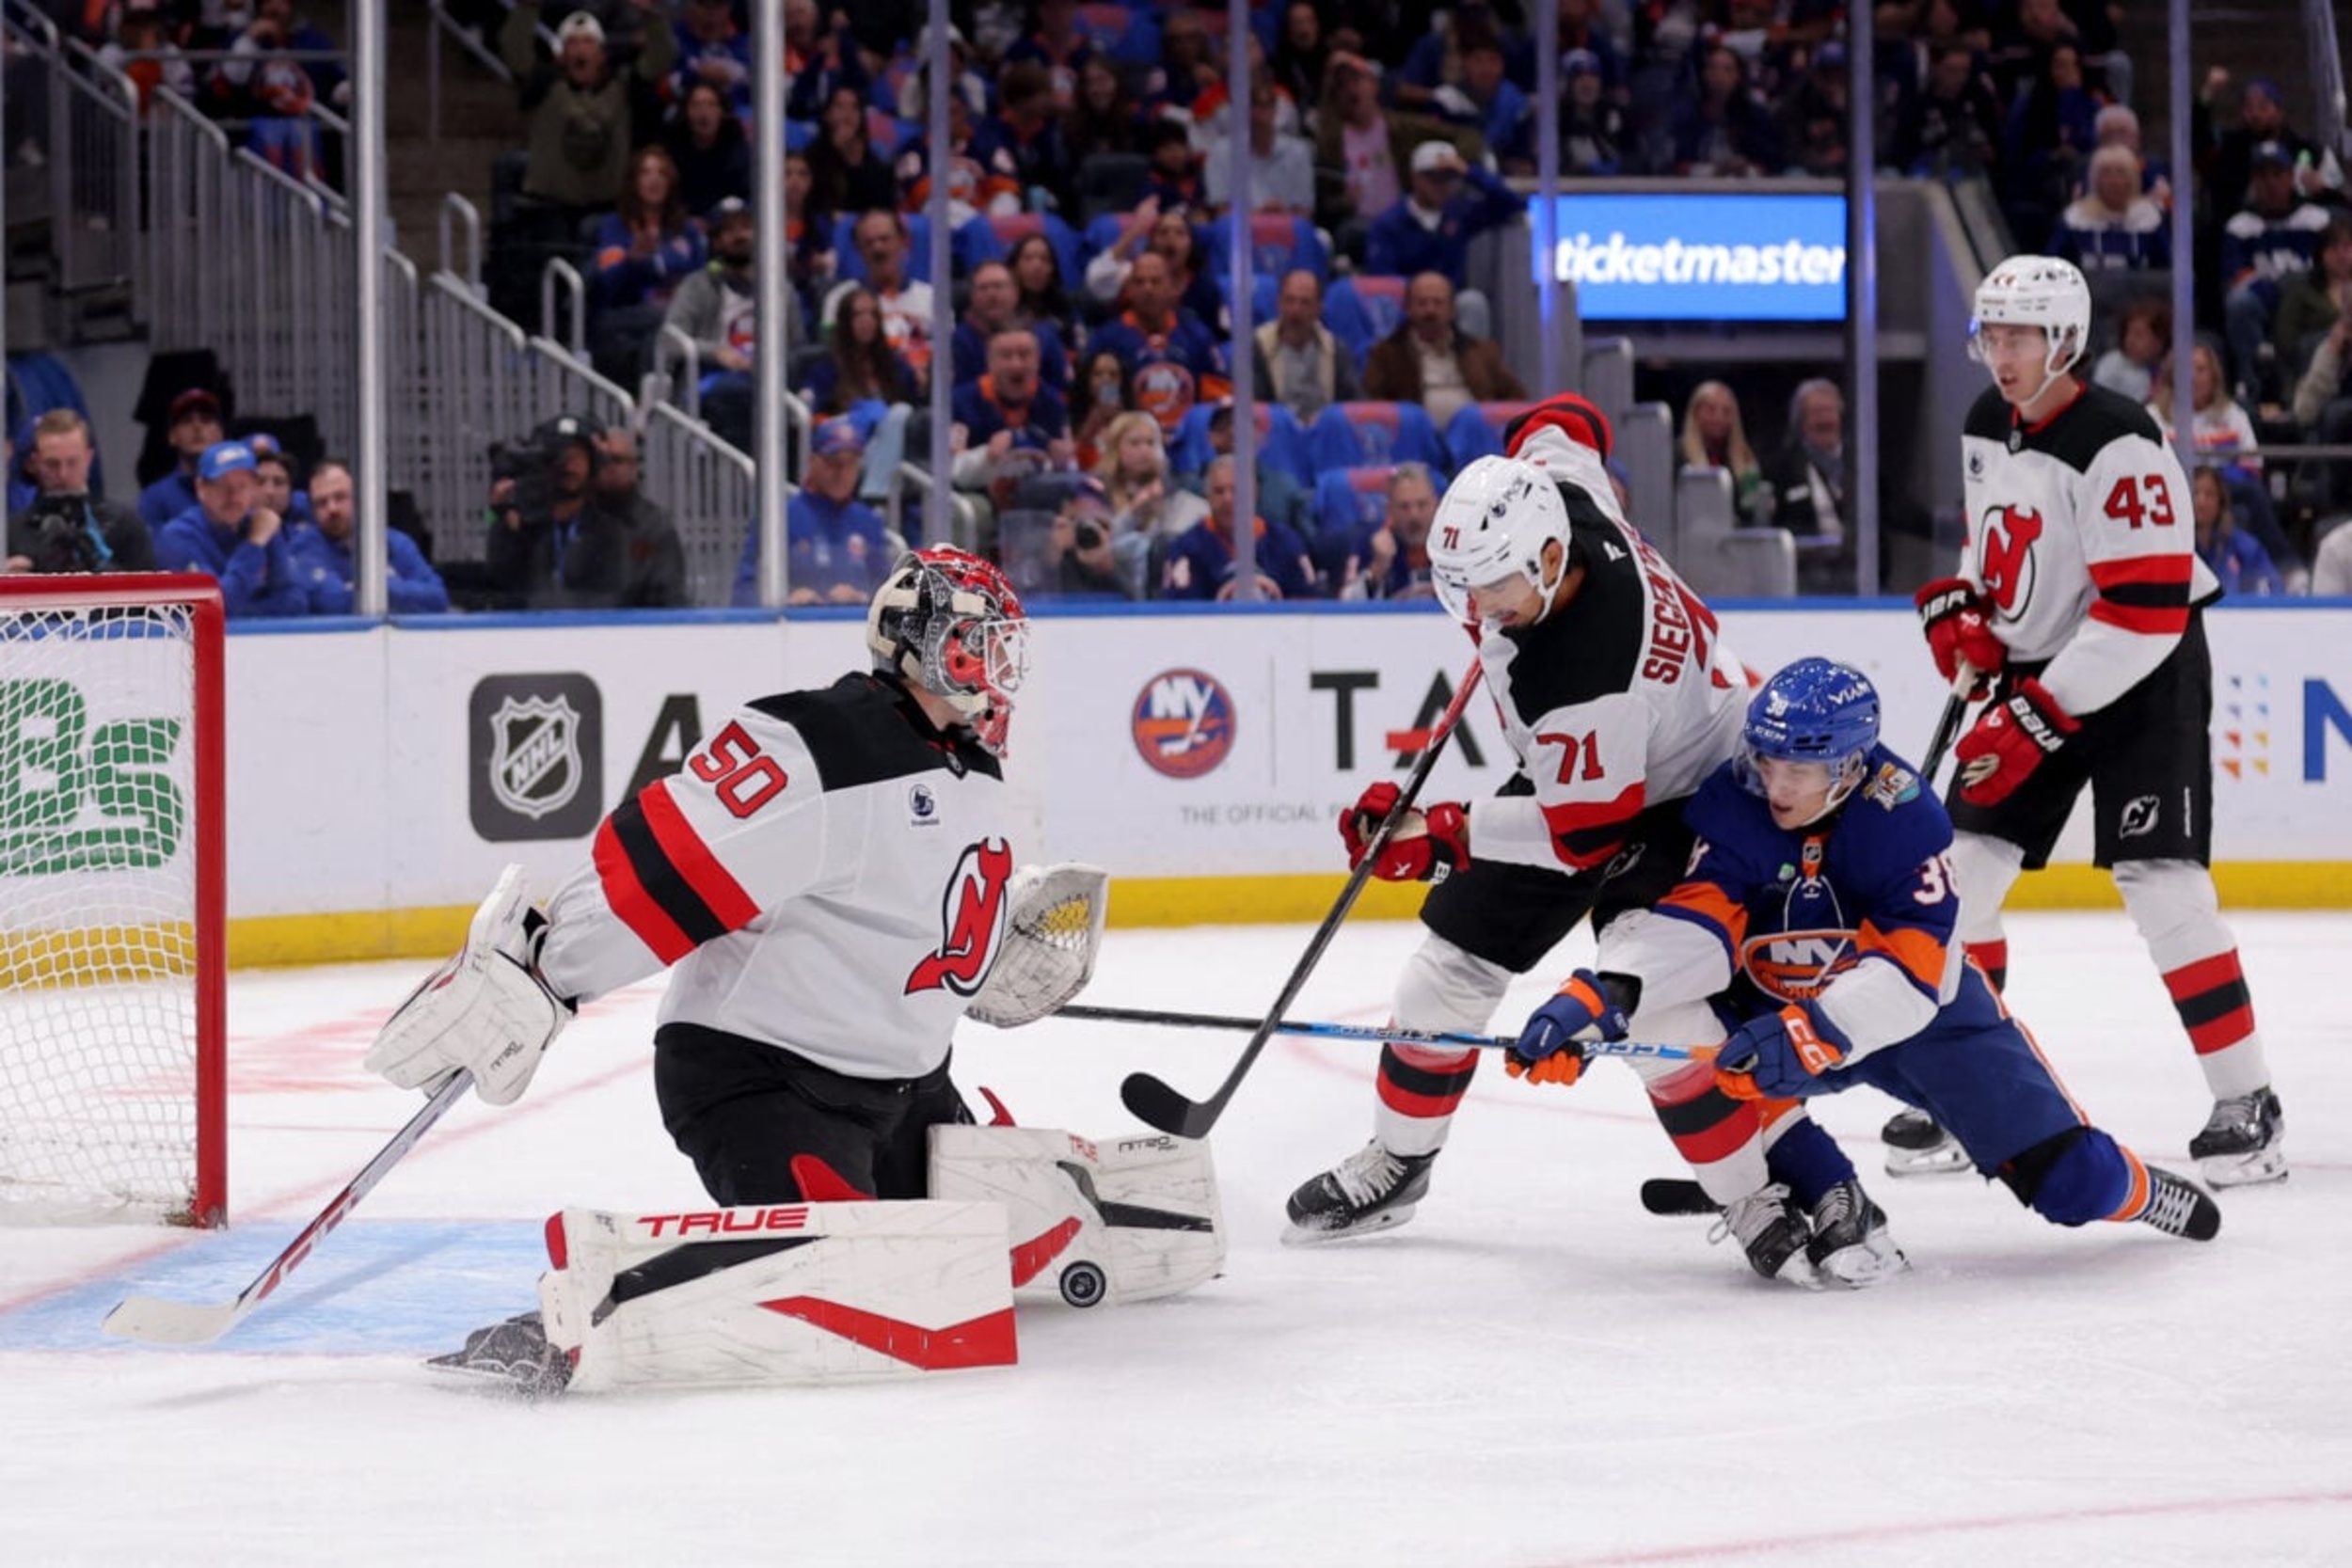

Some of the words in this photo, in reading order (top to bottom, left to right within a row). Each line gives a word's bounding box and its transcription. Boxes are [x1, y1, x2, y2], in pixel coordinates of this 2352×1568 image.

[1555, 232, 1846, 284] ticketmaster
[2103, 473, 2175, 529] 43
[1443, 527, 1460, 550] 71
[511, 727, 565, 791] NHL
[689, 719, 787, 819] 50
[1536, 729, 1605, 784] 71
[1181, 805, 1221, 824] THE
[1226, 802, 1321, 824] OFFICIAL
[637, 1207, 809, 1238] TRUE
